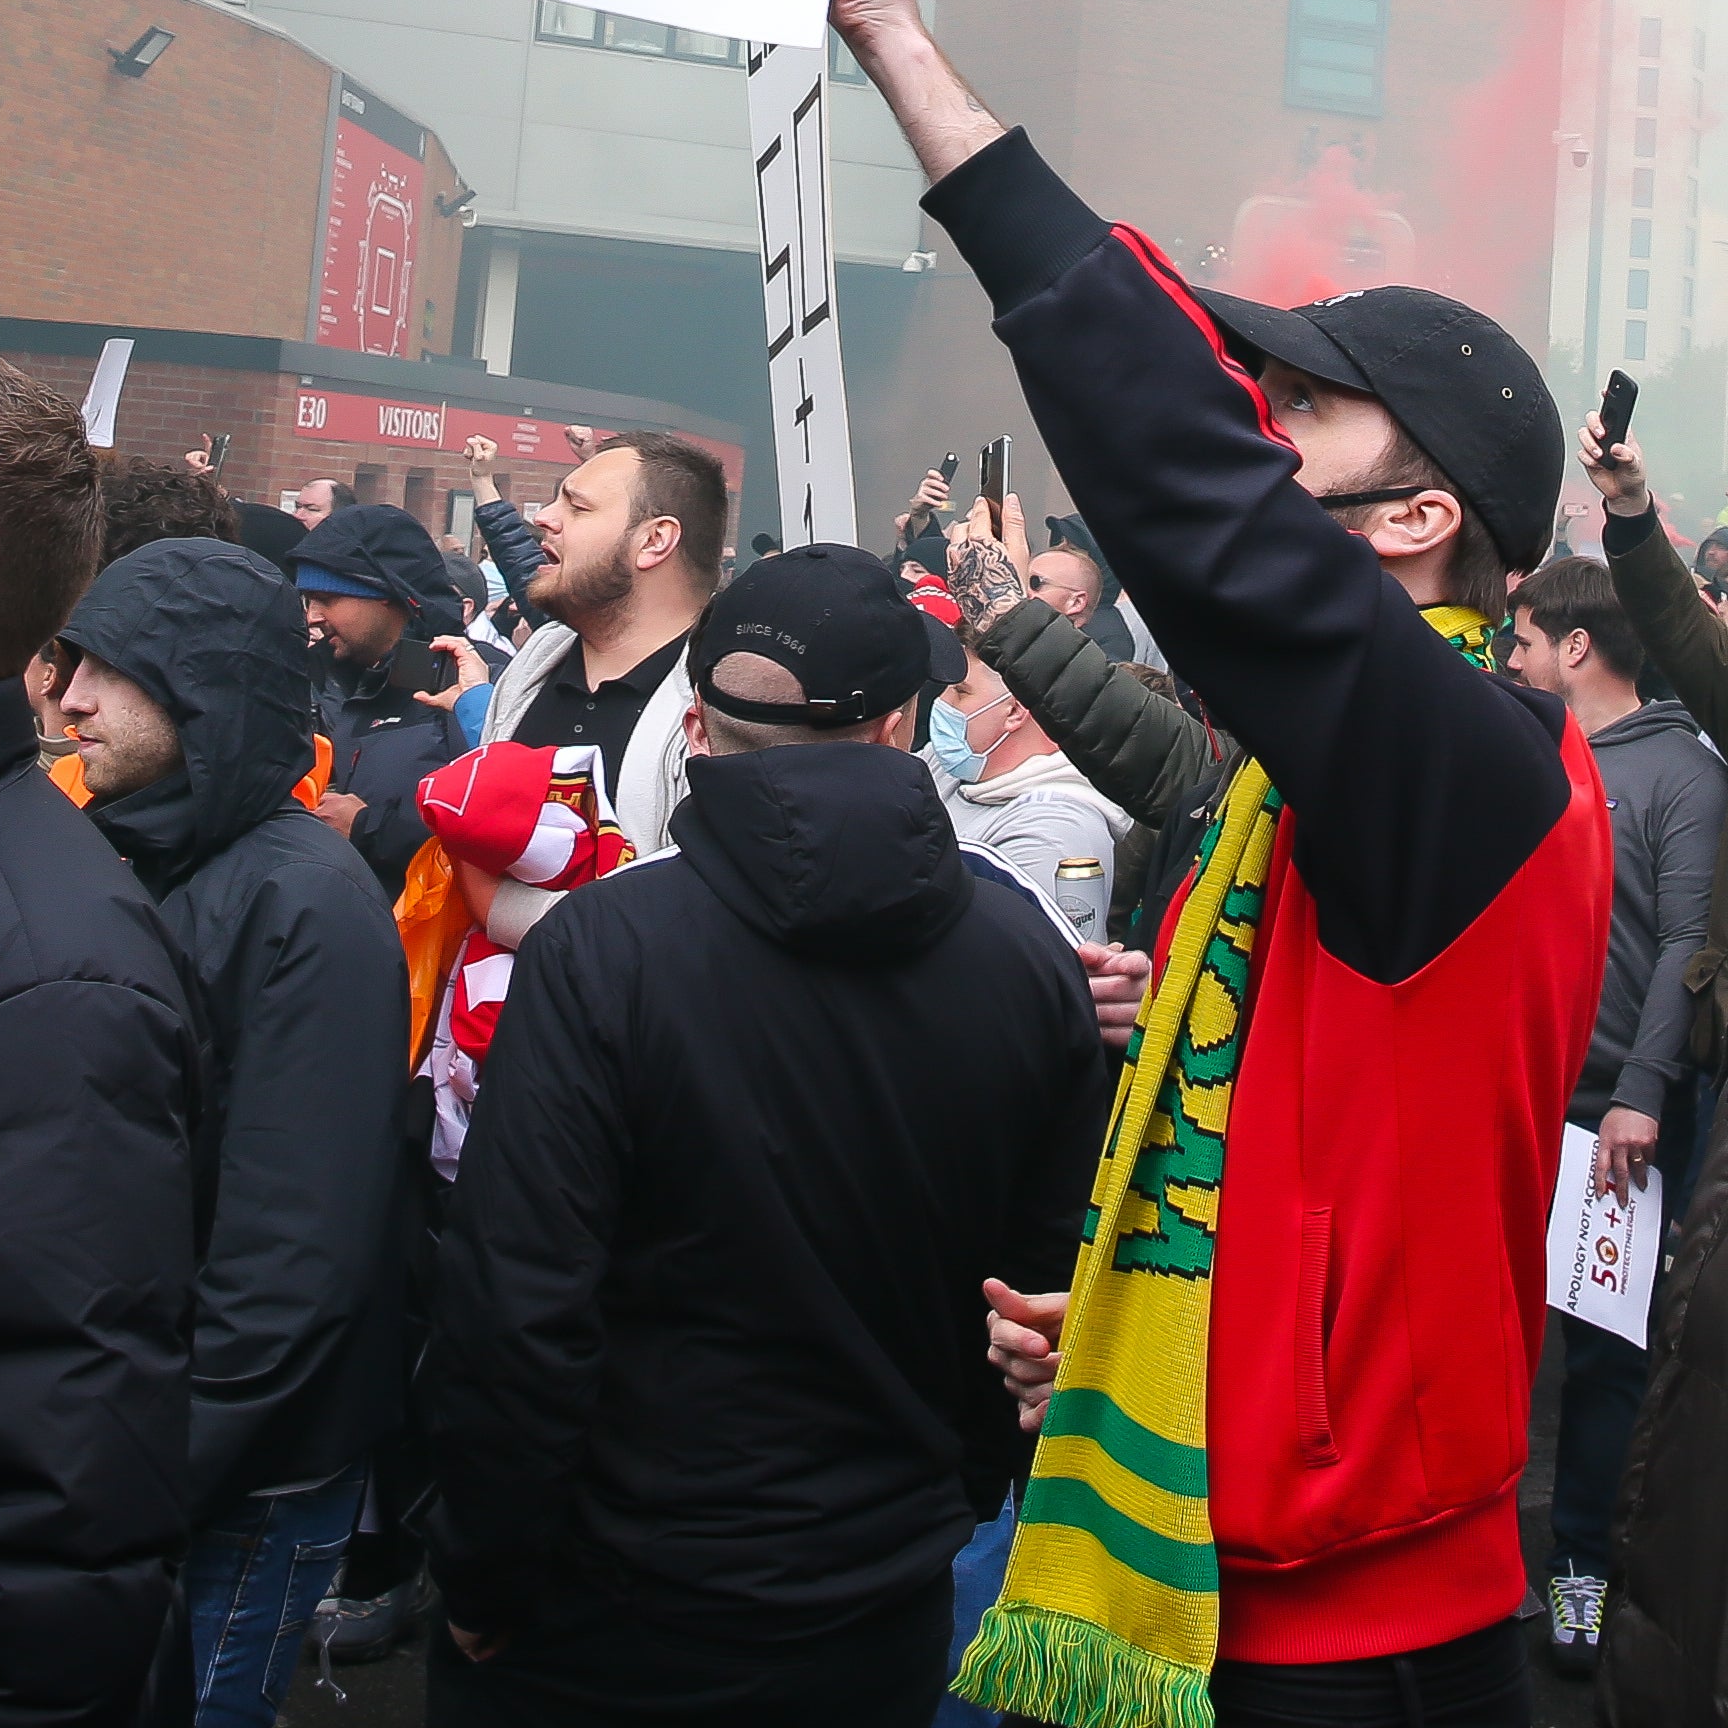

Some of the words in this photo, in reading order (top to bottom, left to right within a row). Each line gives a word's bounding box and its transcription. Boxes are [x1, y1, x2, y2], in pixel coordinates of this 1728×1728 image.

[297, 395, 328, 430] E30
[378, 404, 440, 442] VISITORS
[735, 623, 773, 636] SINCE
[1566, 1241, 1588, 1313] APOLOGY
[1578, 1209, 1592, 1242] NOT
